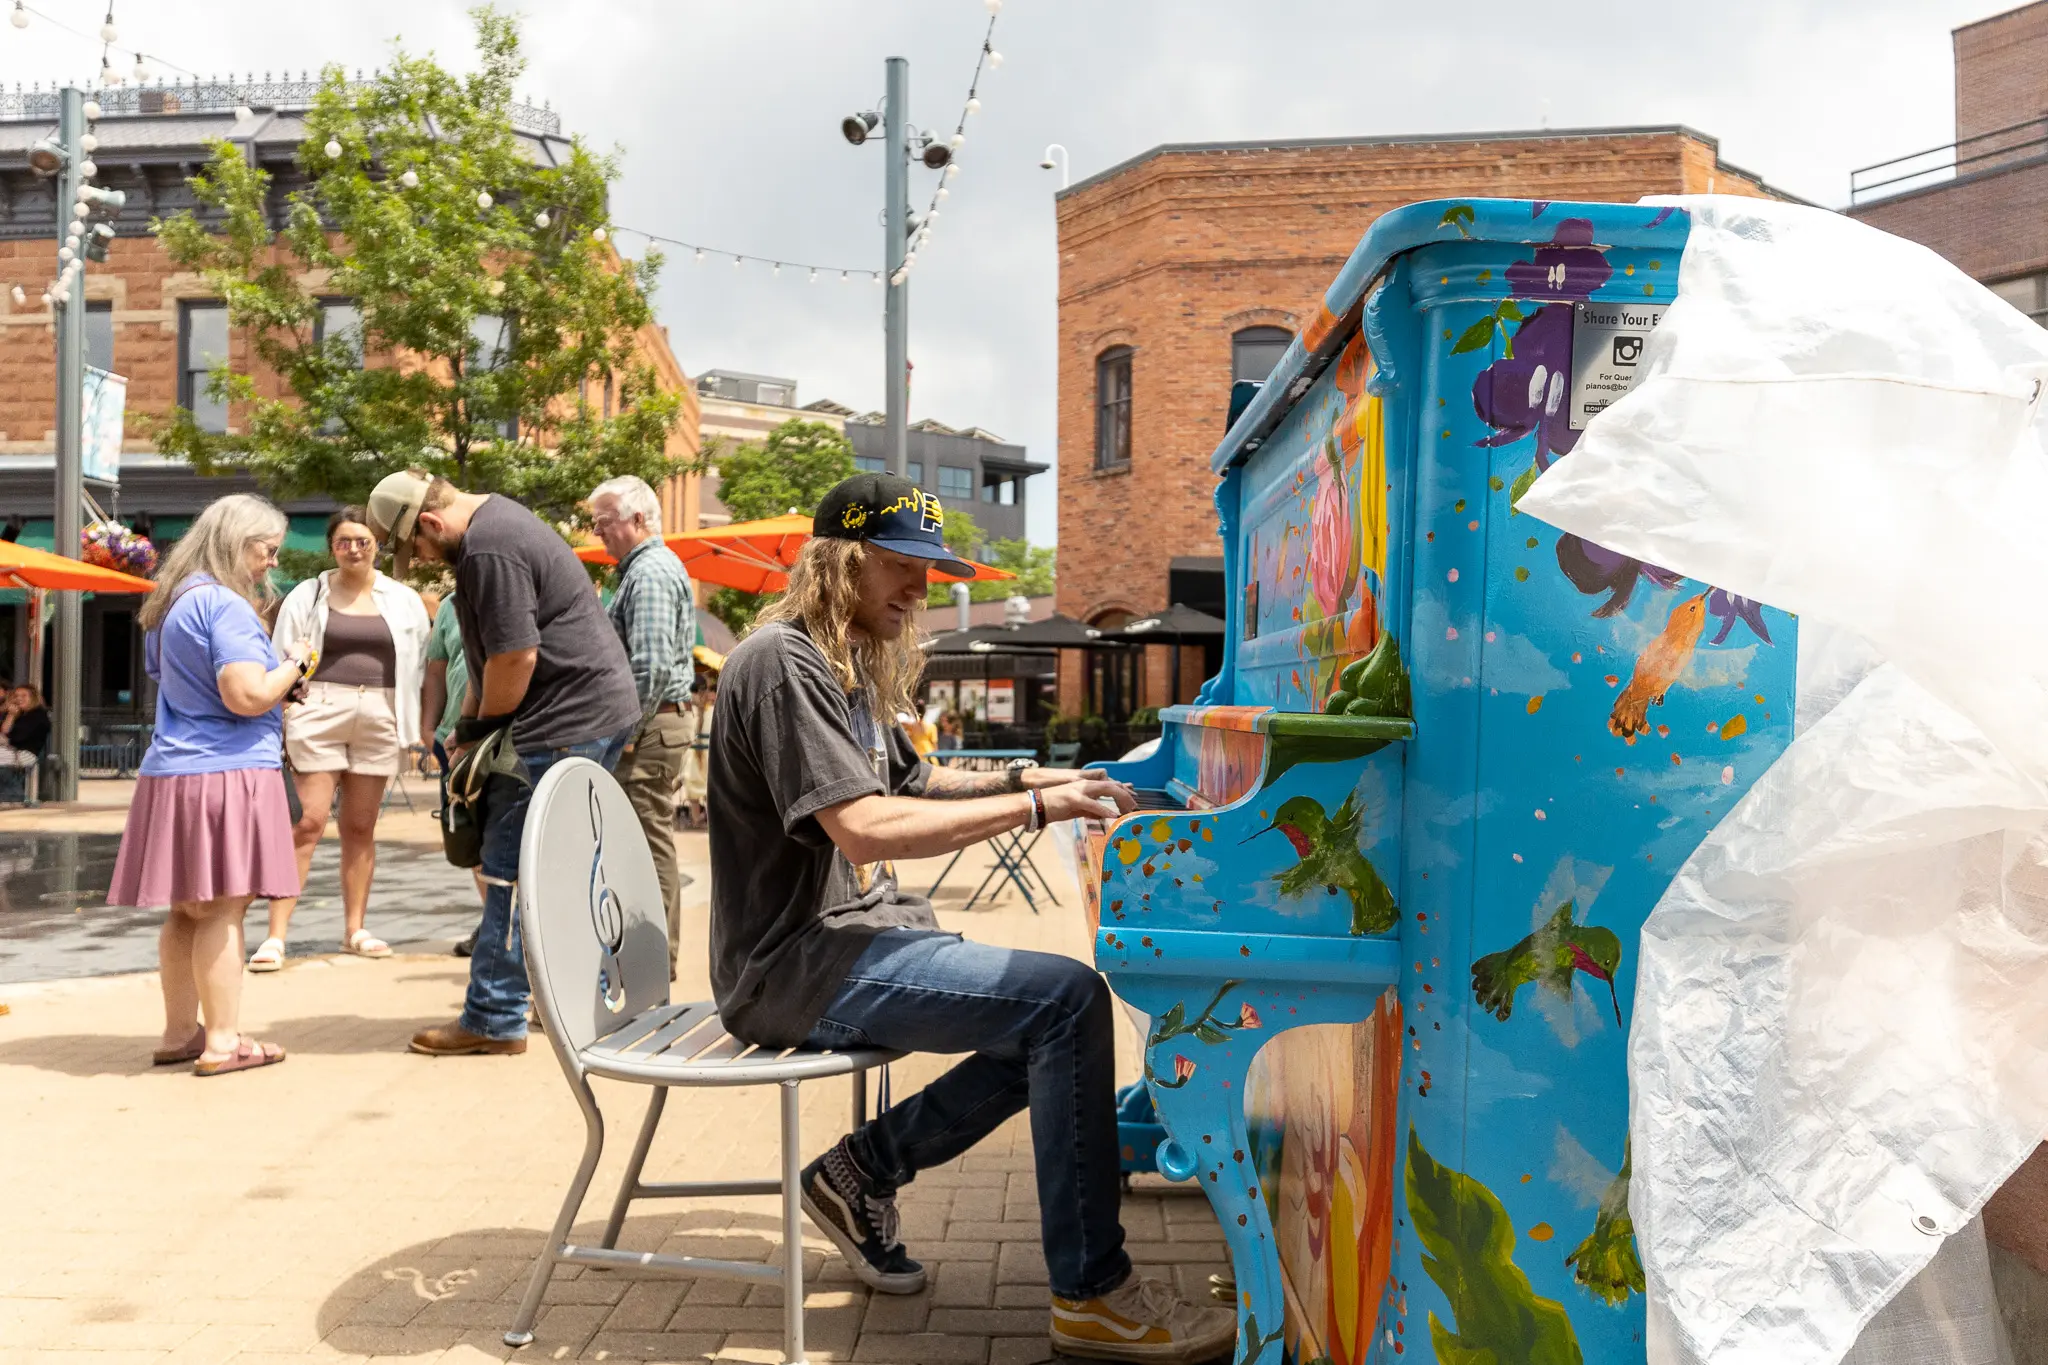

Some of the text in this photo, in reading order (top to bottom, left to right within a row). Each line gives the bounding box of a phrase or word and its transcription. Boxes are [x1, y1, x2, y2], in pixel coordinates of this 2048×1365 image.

[1583, 311, 1661, 326] Share Your E
